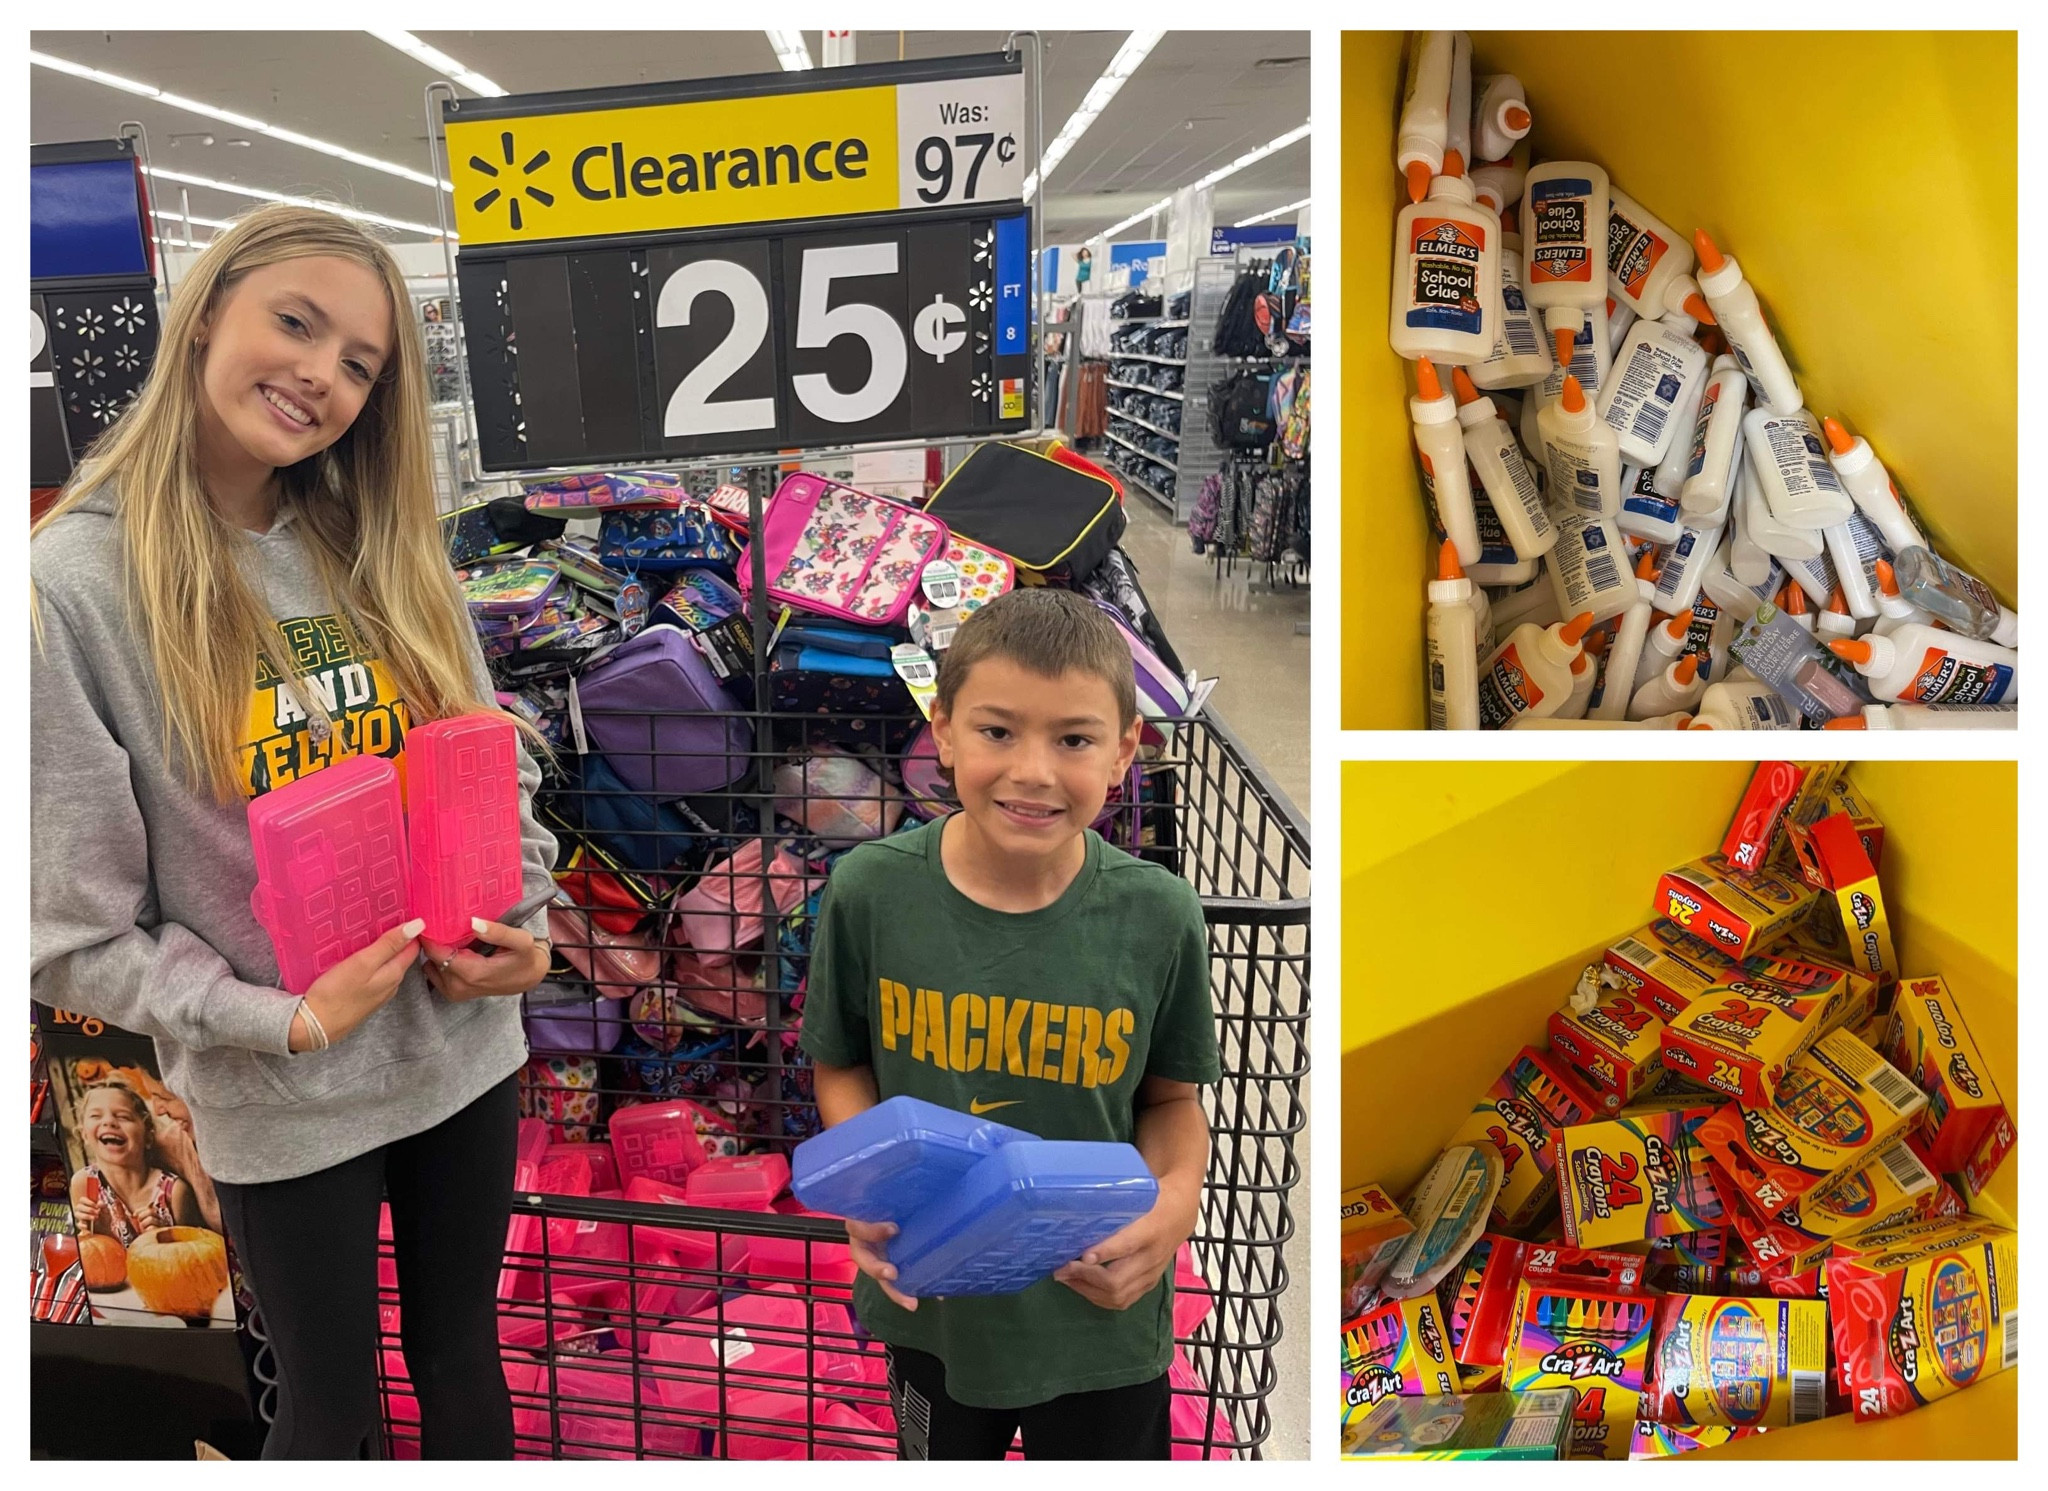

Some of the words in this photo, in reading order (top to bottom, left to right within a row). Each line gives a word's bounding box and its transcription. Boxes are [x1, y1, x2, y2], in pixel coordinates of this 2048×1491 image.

[939, 102, 990, 125] Was:
[571, 137, 869, 201] Clearance
[915, 132, 1016, 204] 97¢
[1548, 207, 1576, 219] Glue
[1539, 219, 1581, 234] School
[1420, 242, 1476, 259] ELMER'S
[1536, 248, 1583, 261] ELMER'S
[1620, 236, 1649, 283] ELMER'S
[1003, 283, 1022, 299] FT
[1421, 270, 1471, 289] School
[1426, 284, 1460, 300] Glue
[656, 242, 967, 438] 25¢
[1006, 326, 1016, 341] 8
[1693, 607, 1715, 618] ER'S
[1685, 643, 1697, 652] ue
[1687, 630, 1709, 643] ool
[1745, 630, 1772, 664] CELEBRATE
[1749, 644, 1770, 669] EARTH
[1768, 627, 1781, 644] DAY
[1780, 635, 1788, 644] LE
[1762, 657, 1779, 679] JOUR
[1780, 629, 1801, 652] TERRE
[1496, 664, 1525, 708] ELMER'S
[1769, 666, 1782, 682] CLEAN
[1921, 660, 1953, 701] ELMER'S
[276, 663, 371, 727] AND
[1480, 683, 1506, 724] School
[1961, 682, 1983, 704] Glue
[1734, 842, 1753, 865] 24
[1667, 889, 1702, 913] Crayons
[1668, 898, 1695, 926] 24
[1864, 931, 1882, 972] Crayons
[1613, 965, 1645, 988] Crayons
[1589, 1007, 1640, 1041] Crayons
[1601, 998, 1653, 1032] 24
[1697, 1013, 1762, 1039] Crayons
[1713, 999, 1772, 1028] 24
[1910, 980, 1941, 998] 24
[1926, 999, 1957, 1049] Crayons
[879, 978, 1135, 1089] PACKERS
[1561, 1018, 1571, 1027] New
[1592, 1038, 1604, 1051] Lasts
[1697, 1026, 1718, 1037] School
[1672, 1029, 1684, 1038] New
[1710, 1042, 1726, 1054] Lasts
[1725, 1048, 1751, 1063] Longer!
[1588, 1065, 1618, 1087] Crayons
[1593, 1054, 1616, 1080] 24
[1713, 1059, 1742, 1087] 24
[1708, 1076, 1744, 1096] Crayons
[1424, 1184, 1433, 1201] ICE
[1574, 1160, 1583, 1184] School
[1579, 1183, 1591, 1211] Quality!
[1585, 1147, 1611, 1218] Crayons
[1601, 1152, 1644, 1210] 24
[1755, 1182, 1784, 1209] 24
[1565, 1211, 1575, 1238] Longer!
[1752, 1236, 1779, 1262] 24
[1924, 1232, 1982, 1252] Crayons
[1529, 1249, 1557, 1267] 24
[1859, 1387, 1881, 1416] 24
